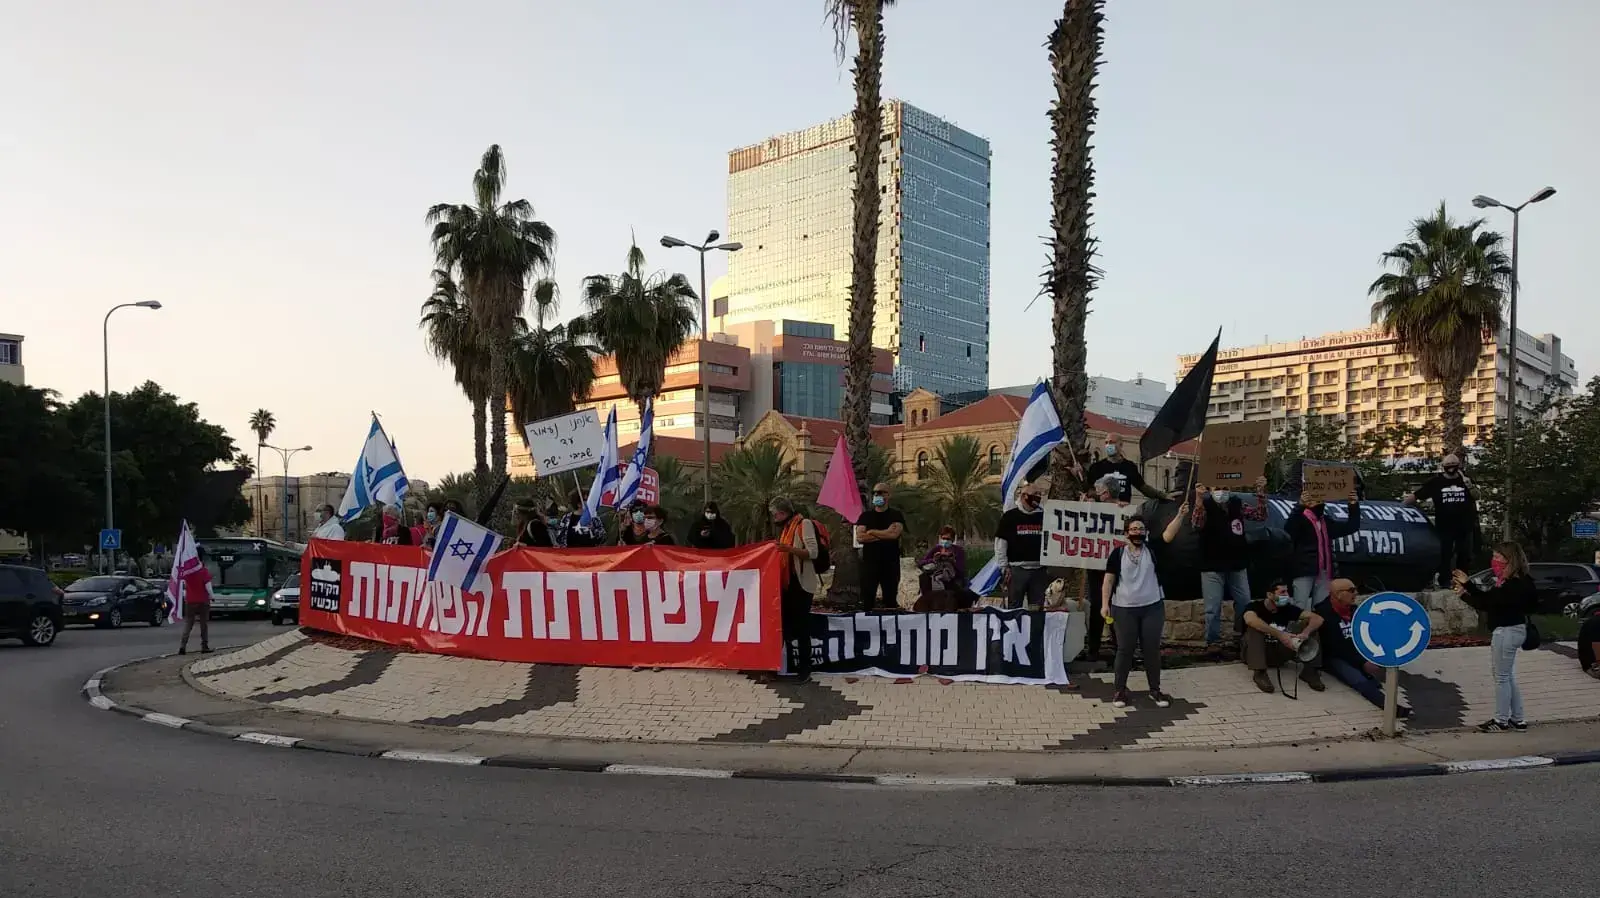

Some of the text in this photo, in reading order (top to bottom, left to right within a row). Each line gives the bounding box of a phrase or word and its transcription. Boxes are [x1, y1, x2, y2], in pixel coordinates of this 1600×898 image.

[569, 415, 593, 432] אנחנו
[311, 581, 340, 597] חקירה
[310, 596, 339, 611] עכשיו
[501, 570, 761, 643] משחתת
[827, 611, 1031, 671] אין מחילה
